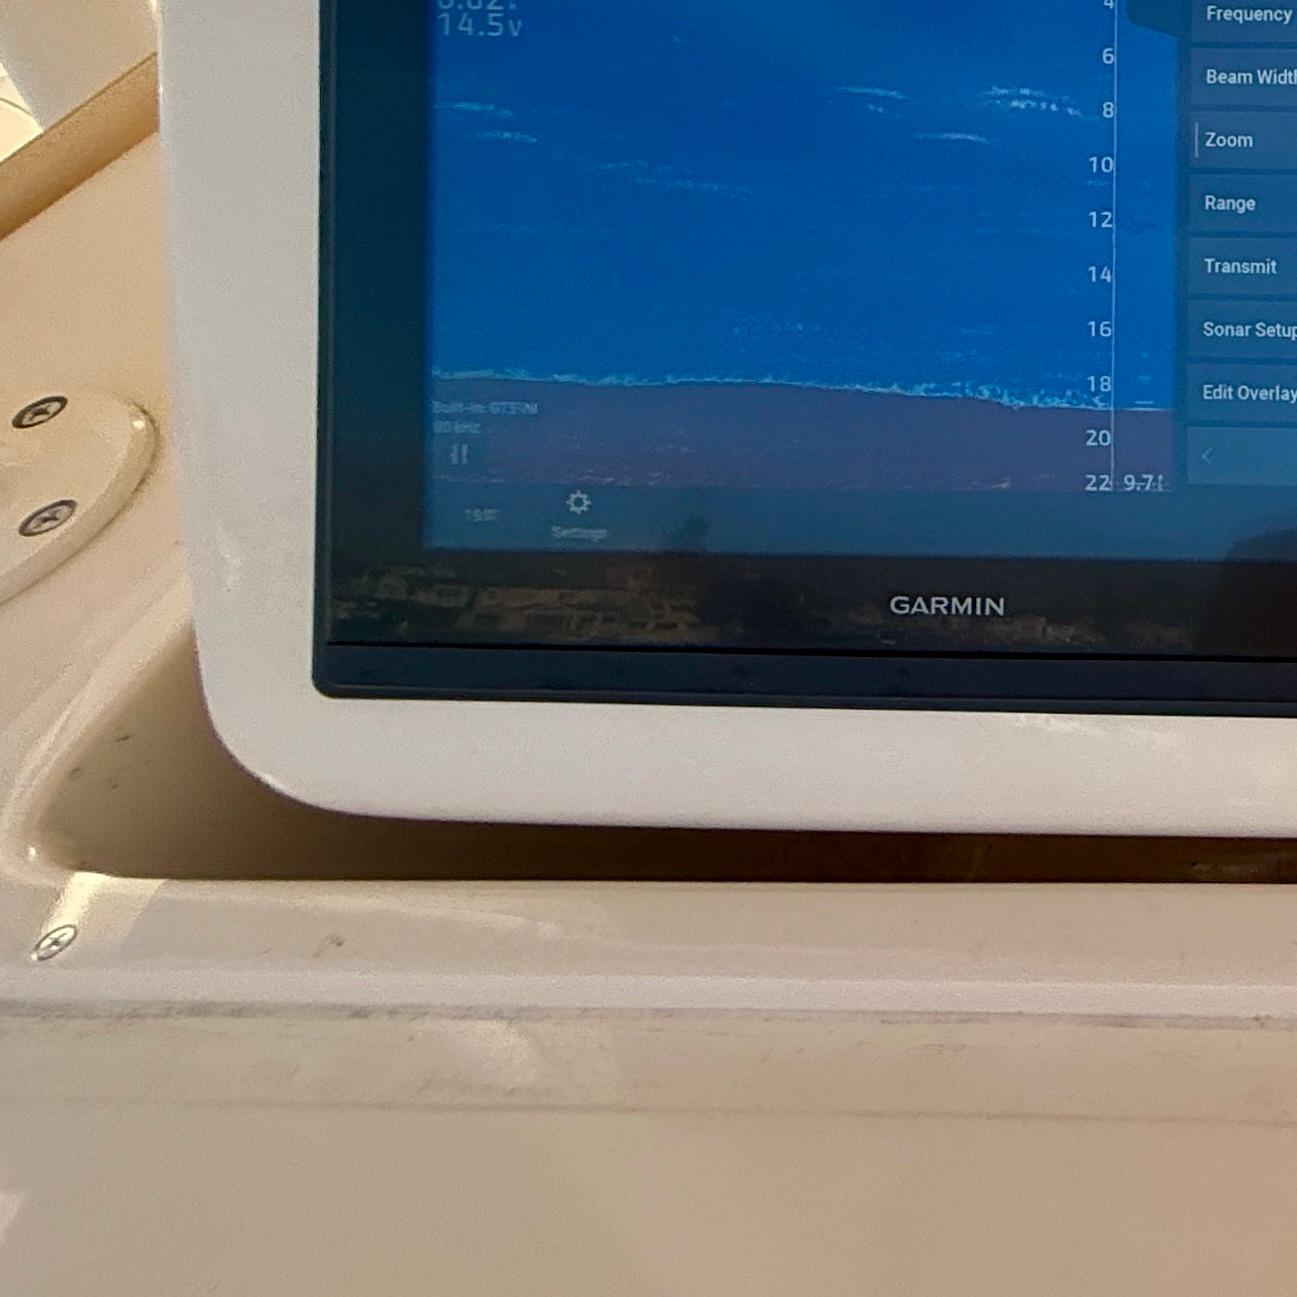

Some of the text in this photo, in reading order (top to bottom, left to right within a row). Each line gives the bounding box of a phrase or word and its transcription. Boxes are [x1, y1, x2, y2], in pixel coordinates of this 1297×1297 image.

[1206, 5, 1293, 27] Frequency
[1102, 48, 1115, 65] 6
[1205, 69, 1253, 86] Beam
[1102, 102, 1115, 119] 8
[1205, 132, 1254, 149] Zoom
[1088, 156, 1114, 174] 10
[1205, 195, 1256, 216] Range
[1088, 211, 1113, 229] 12
[1087, 266, 1112, 283] 14
[1204, 257, 1278, 275] Transmit
[1087, 320, 1112, 338] 16
[1203, 321, 1251, 338] Sonar
[1086, 375, 1112, 393] 18
[1203, 384, 1234, 402] Edit
[1086, 430, 1112, 447] 20
[1085, 474, 1112, 492] 22
[889, 595, 1005, 617] GARMIN
